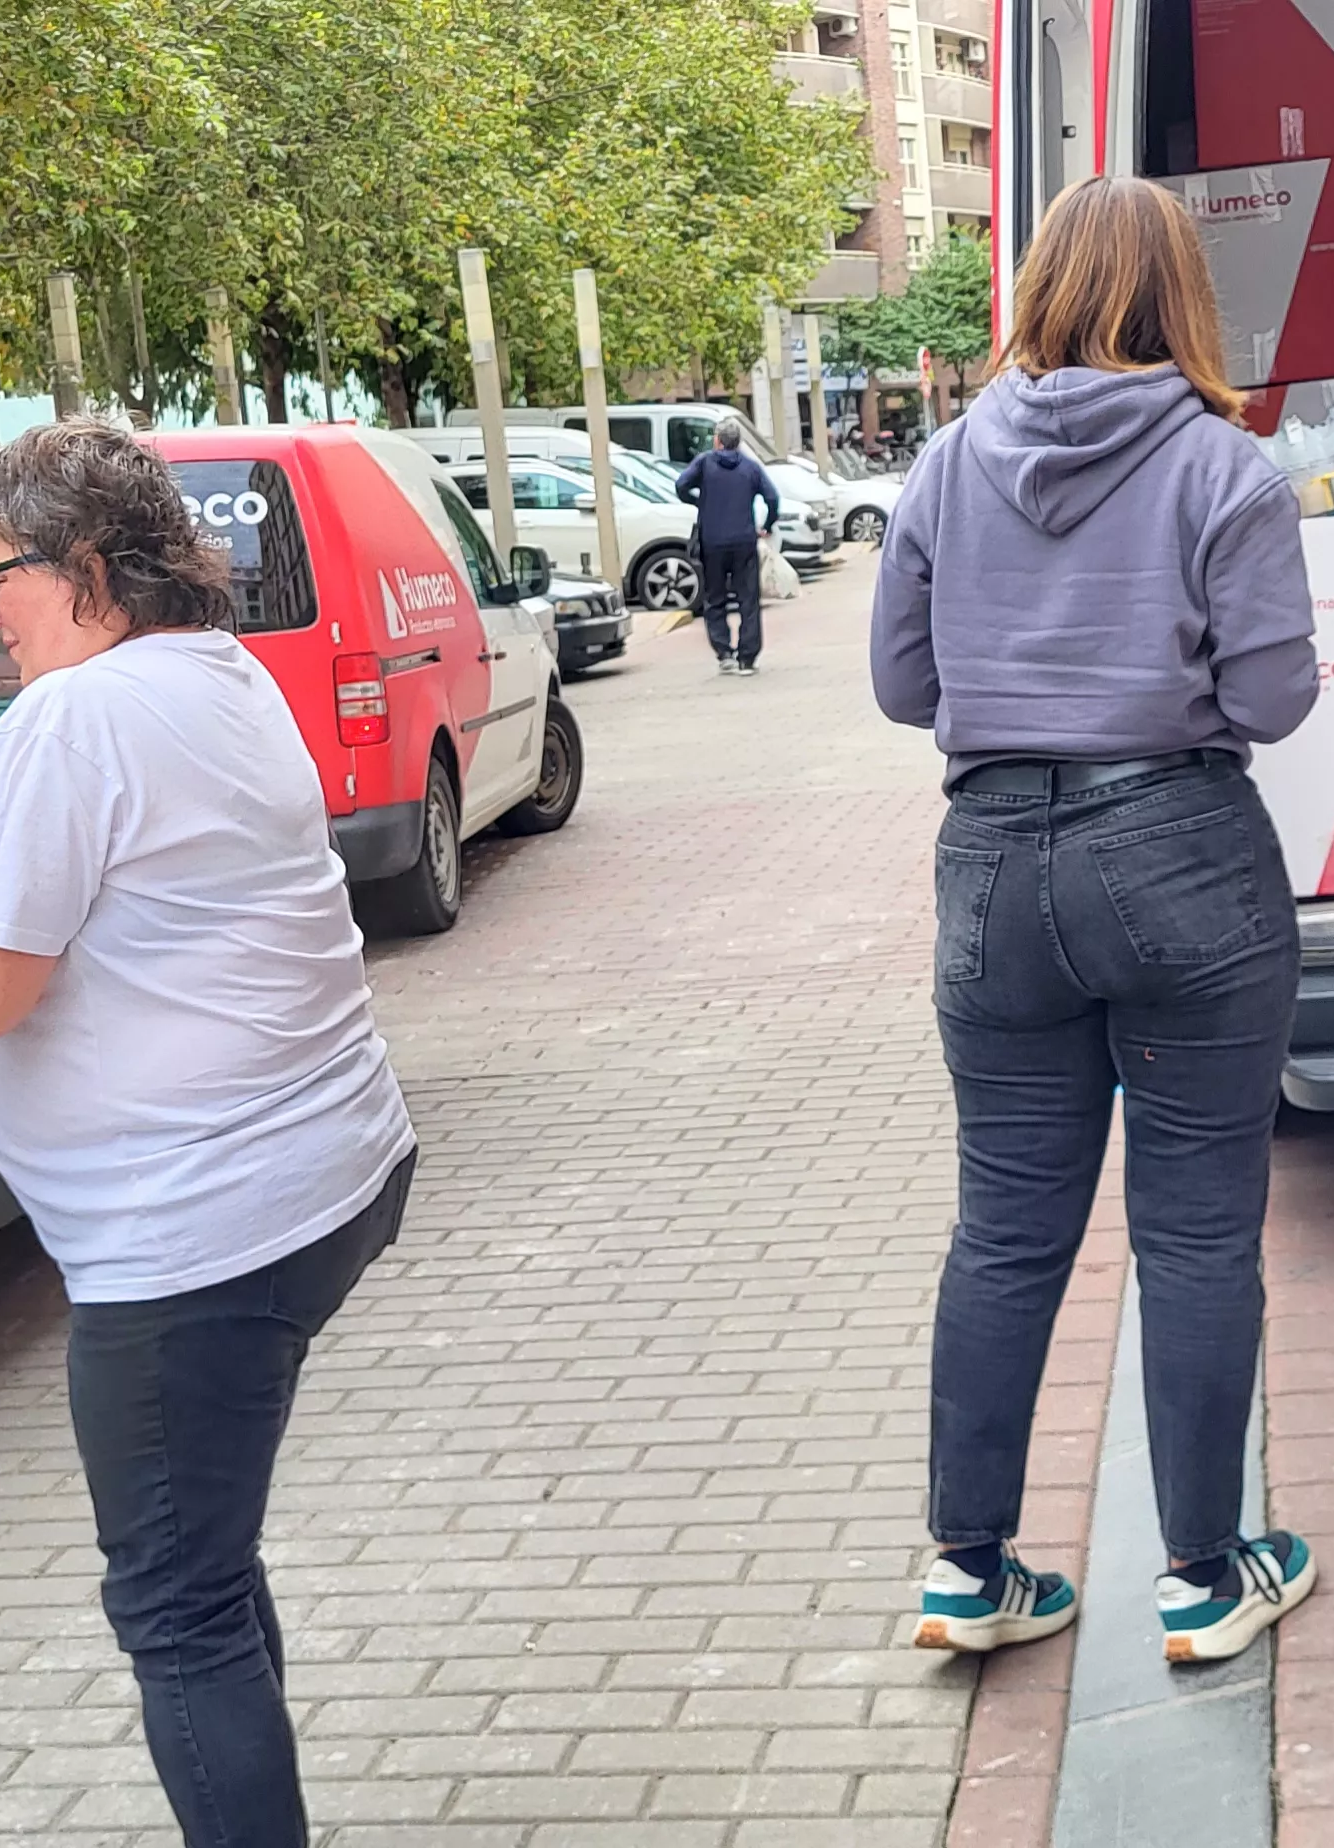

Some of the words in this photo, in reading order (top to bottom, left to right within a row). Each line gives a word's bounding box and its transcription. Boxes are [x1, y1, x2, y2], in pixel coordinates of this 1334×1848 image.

[1191, 190, 1292, 216] Humeco
[181, 490, 269, 527] eco
[395, 567, 457, 612] Humeco
